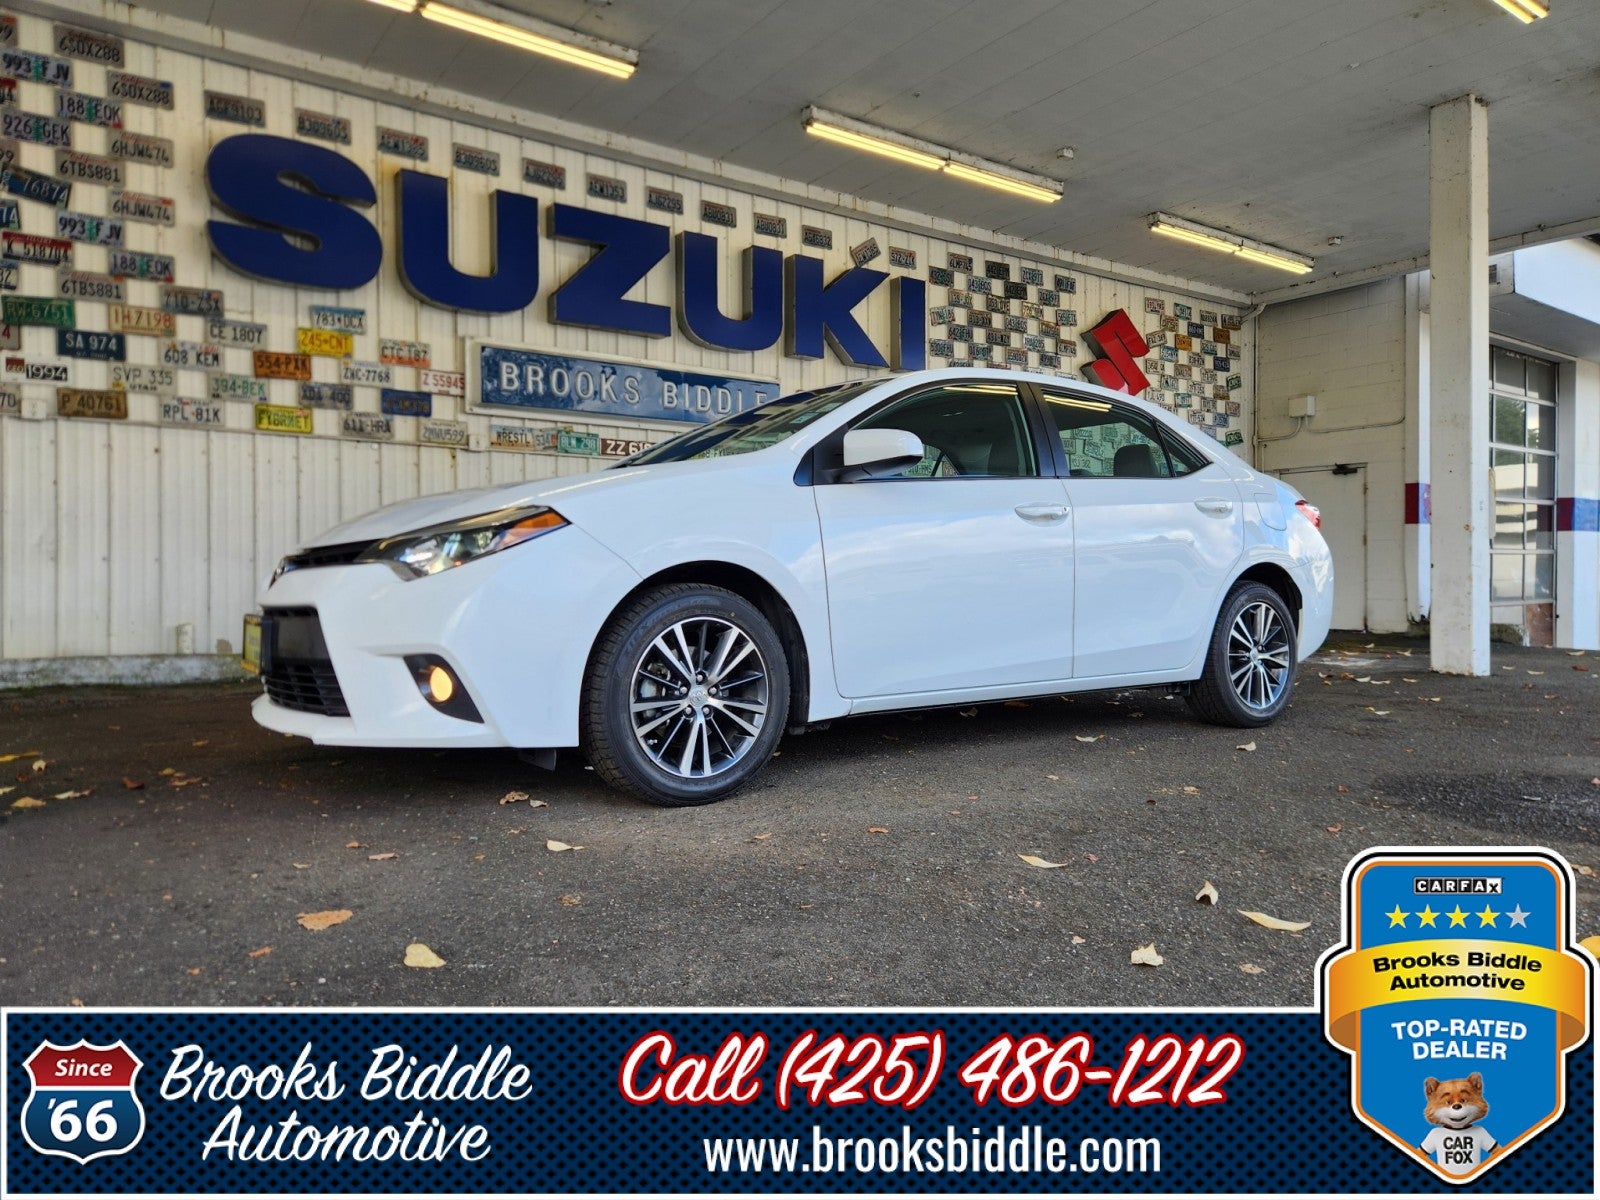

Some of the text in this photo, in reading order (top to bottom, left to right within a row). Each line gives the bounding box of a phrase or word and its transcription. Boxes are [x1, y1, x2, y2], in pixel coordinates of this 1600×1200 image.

[4, 114, 32, 136] 926
[207, 133, 927, 372] SUZUKI
[65, 333, 117, 351] SA 974
[232, 327, 263, 344] 1807
[164, 349, 189, 364] 608
[28, 364, 67, 381] 1994
[113, 367, 174, 386] SVP 335
[500, 360, 641, 405] BROOKS
[606, 440, 626, 456] ZZ
